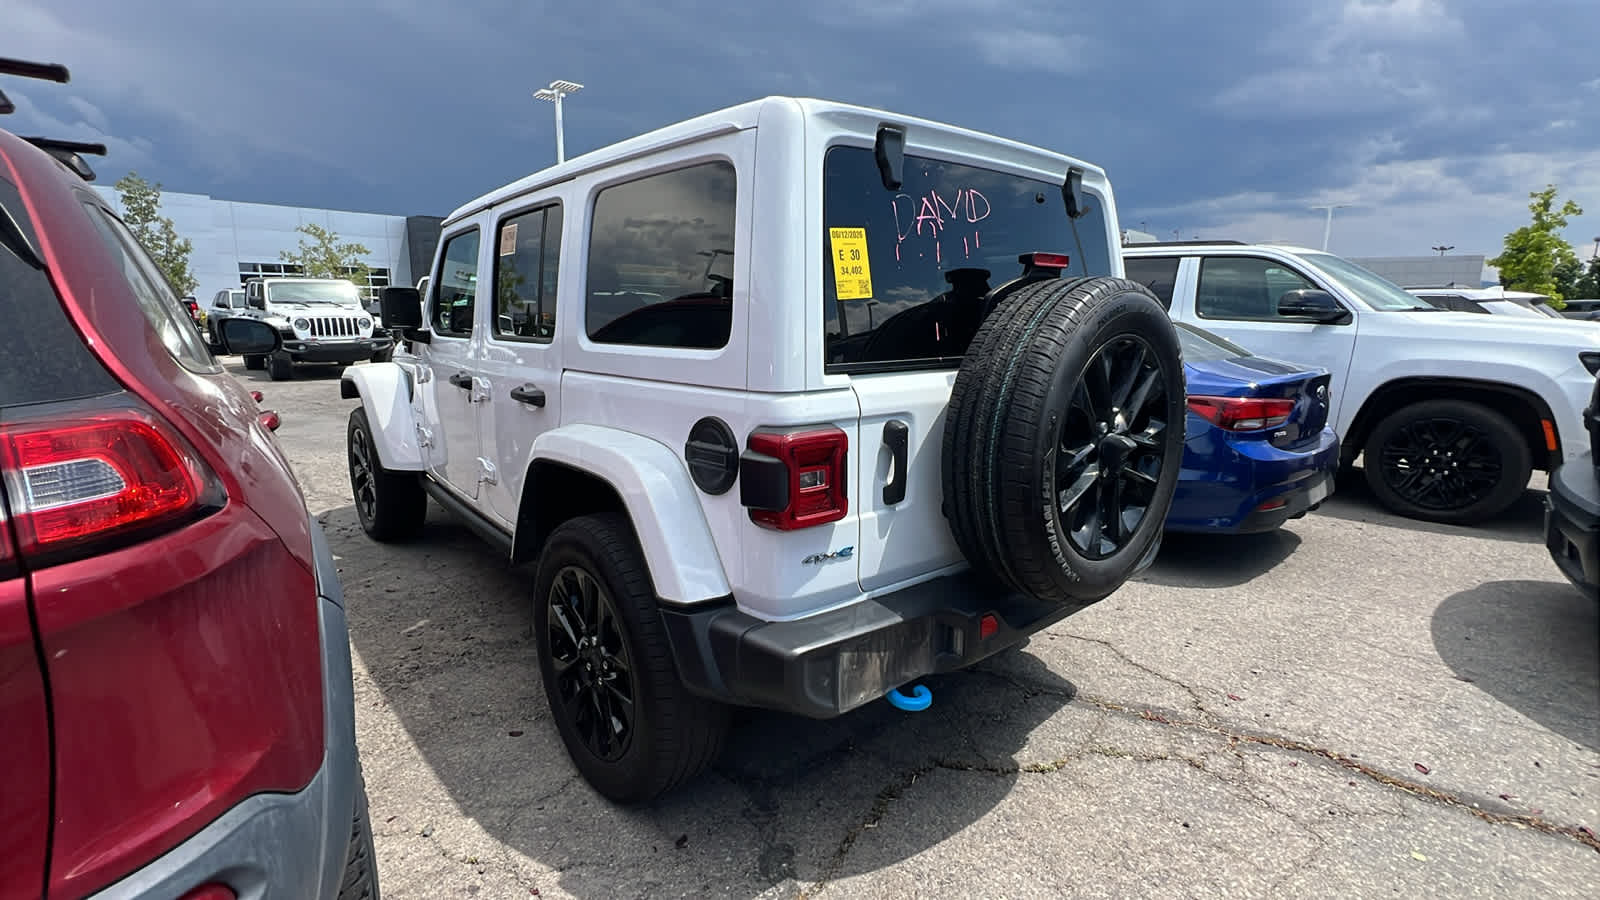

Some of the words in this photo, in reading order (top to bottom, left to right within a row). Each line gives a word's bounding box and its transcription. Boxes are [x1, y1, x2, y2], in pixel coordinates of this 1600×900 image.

[892, 188, 991, 241] DAVID
[839, 249, 845, 261] E
[850, 249, 861, 261] 30
[841, 266, 863, 276] 34,402
